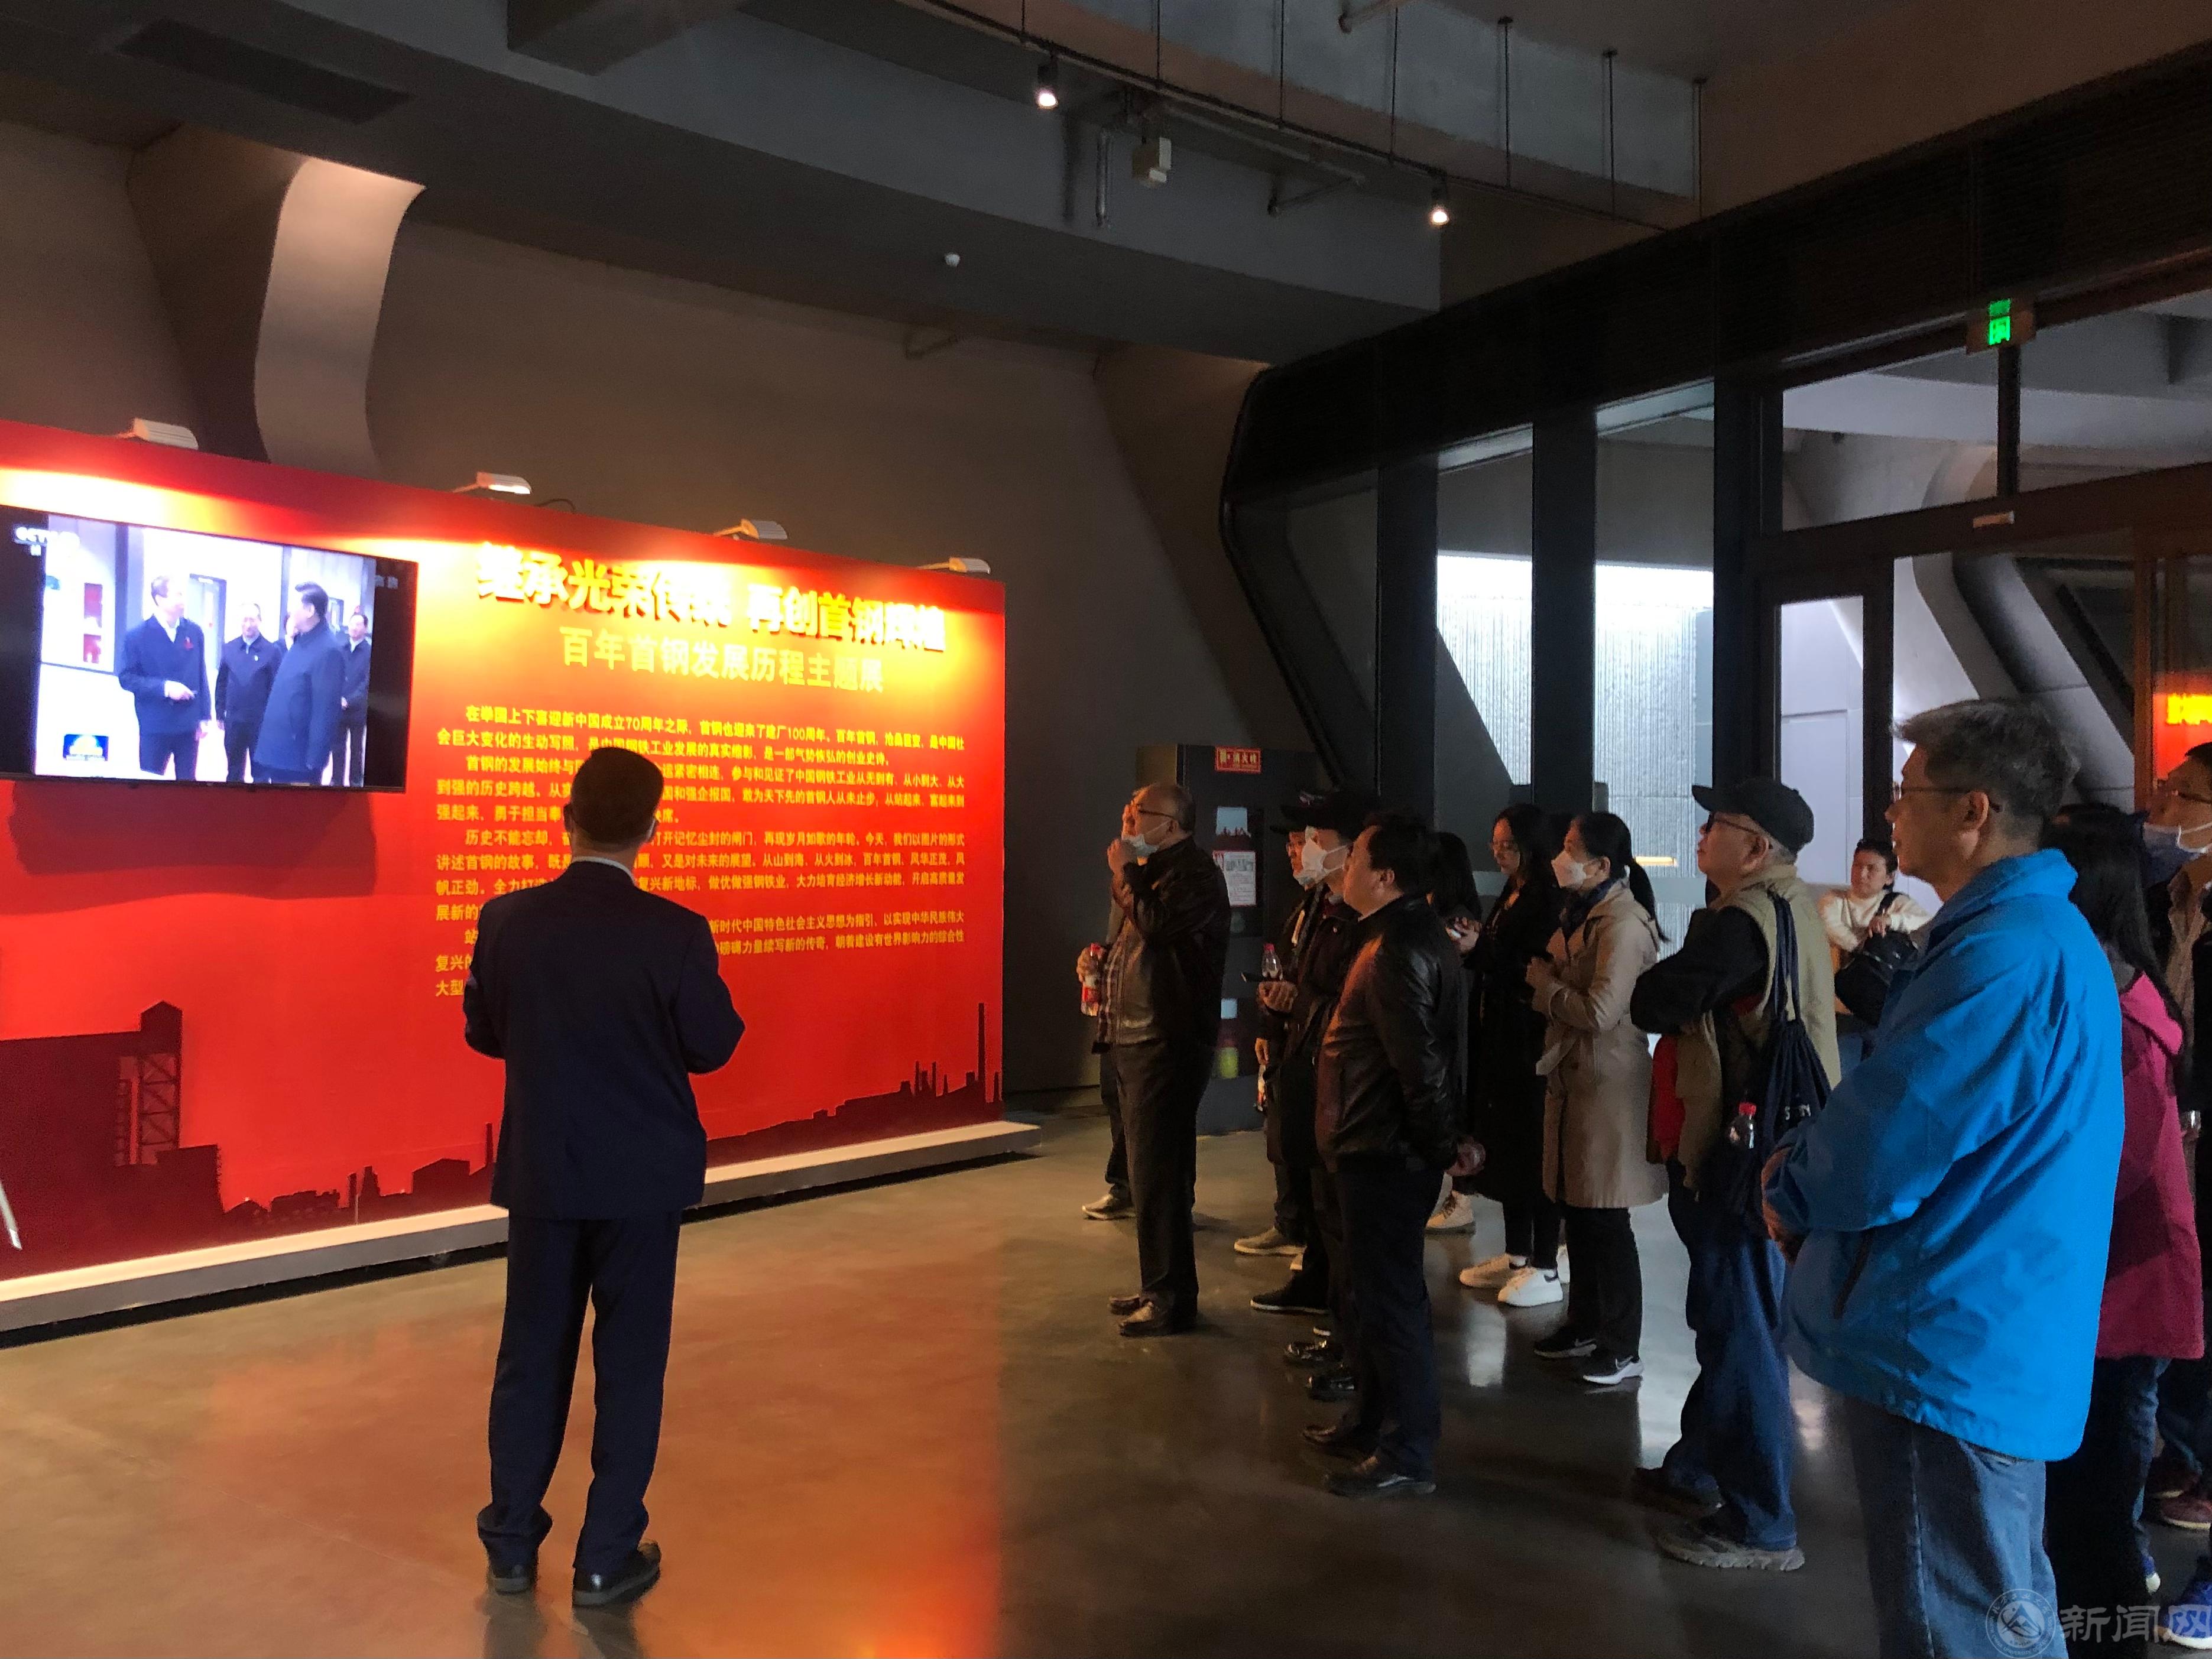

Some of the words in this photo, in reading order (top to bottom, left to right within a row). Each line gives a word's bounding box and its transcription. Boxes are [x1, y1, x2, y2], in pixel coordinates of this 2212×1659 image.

[559, 625, 884, 693] 百年首钢发展历程主题展
[435, 978, 463, 996] 大型
